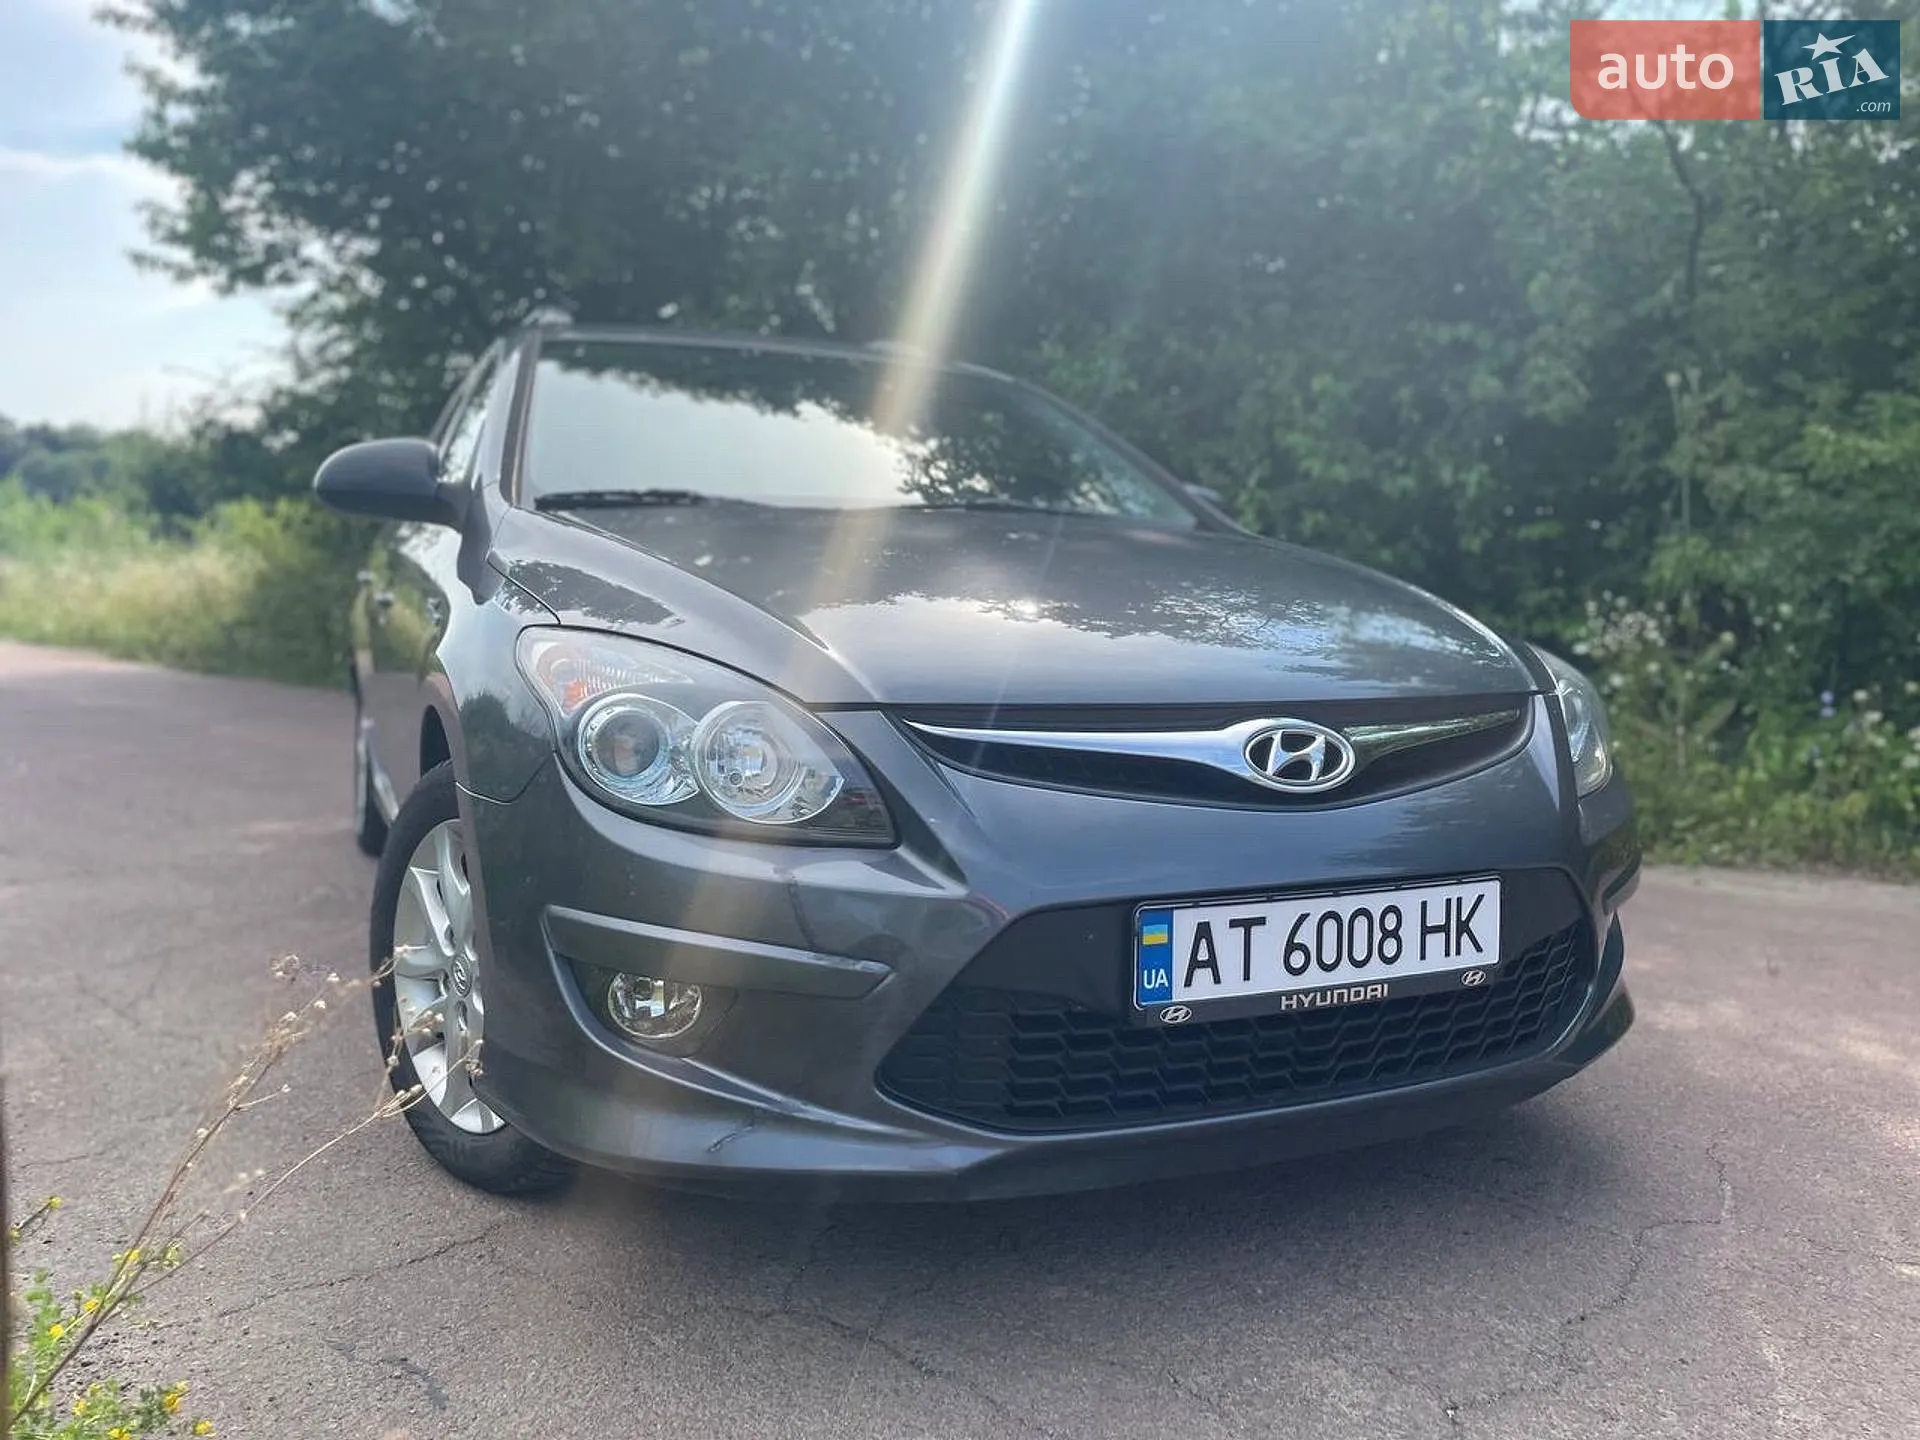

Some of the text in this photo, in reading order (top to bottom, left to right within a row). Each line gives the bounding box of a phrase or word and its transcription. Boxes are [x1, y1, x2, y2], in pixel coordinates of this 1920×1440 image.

[1183, 893, 1486, 988] AT 6008 HK
[1143, 968, 1169, 990] UA
[1280, 982, 1389, 1012] HYUNDAI
